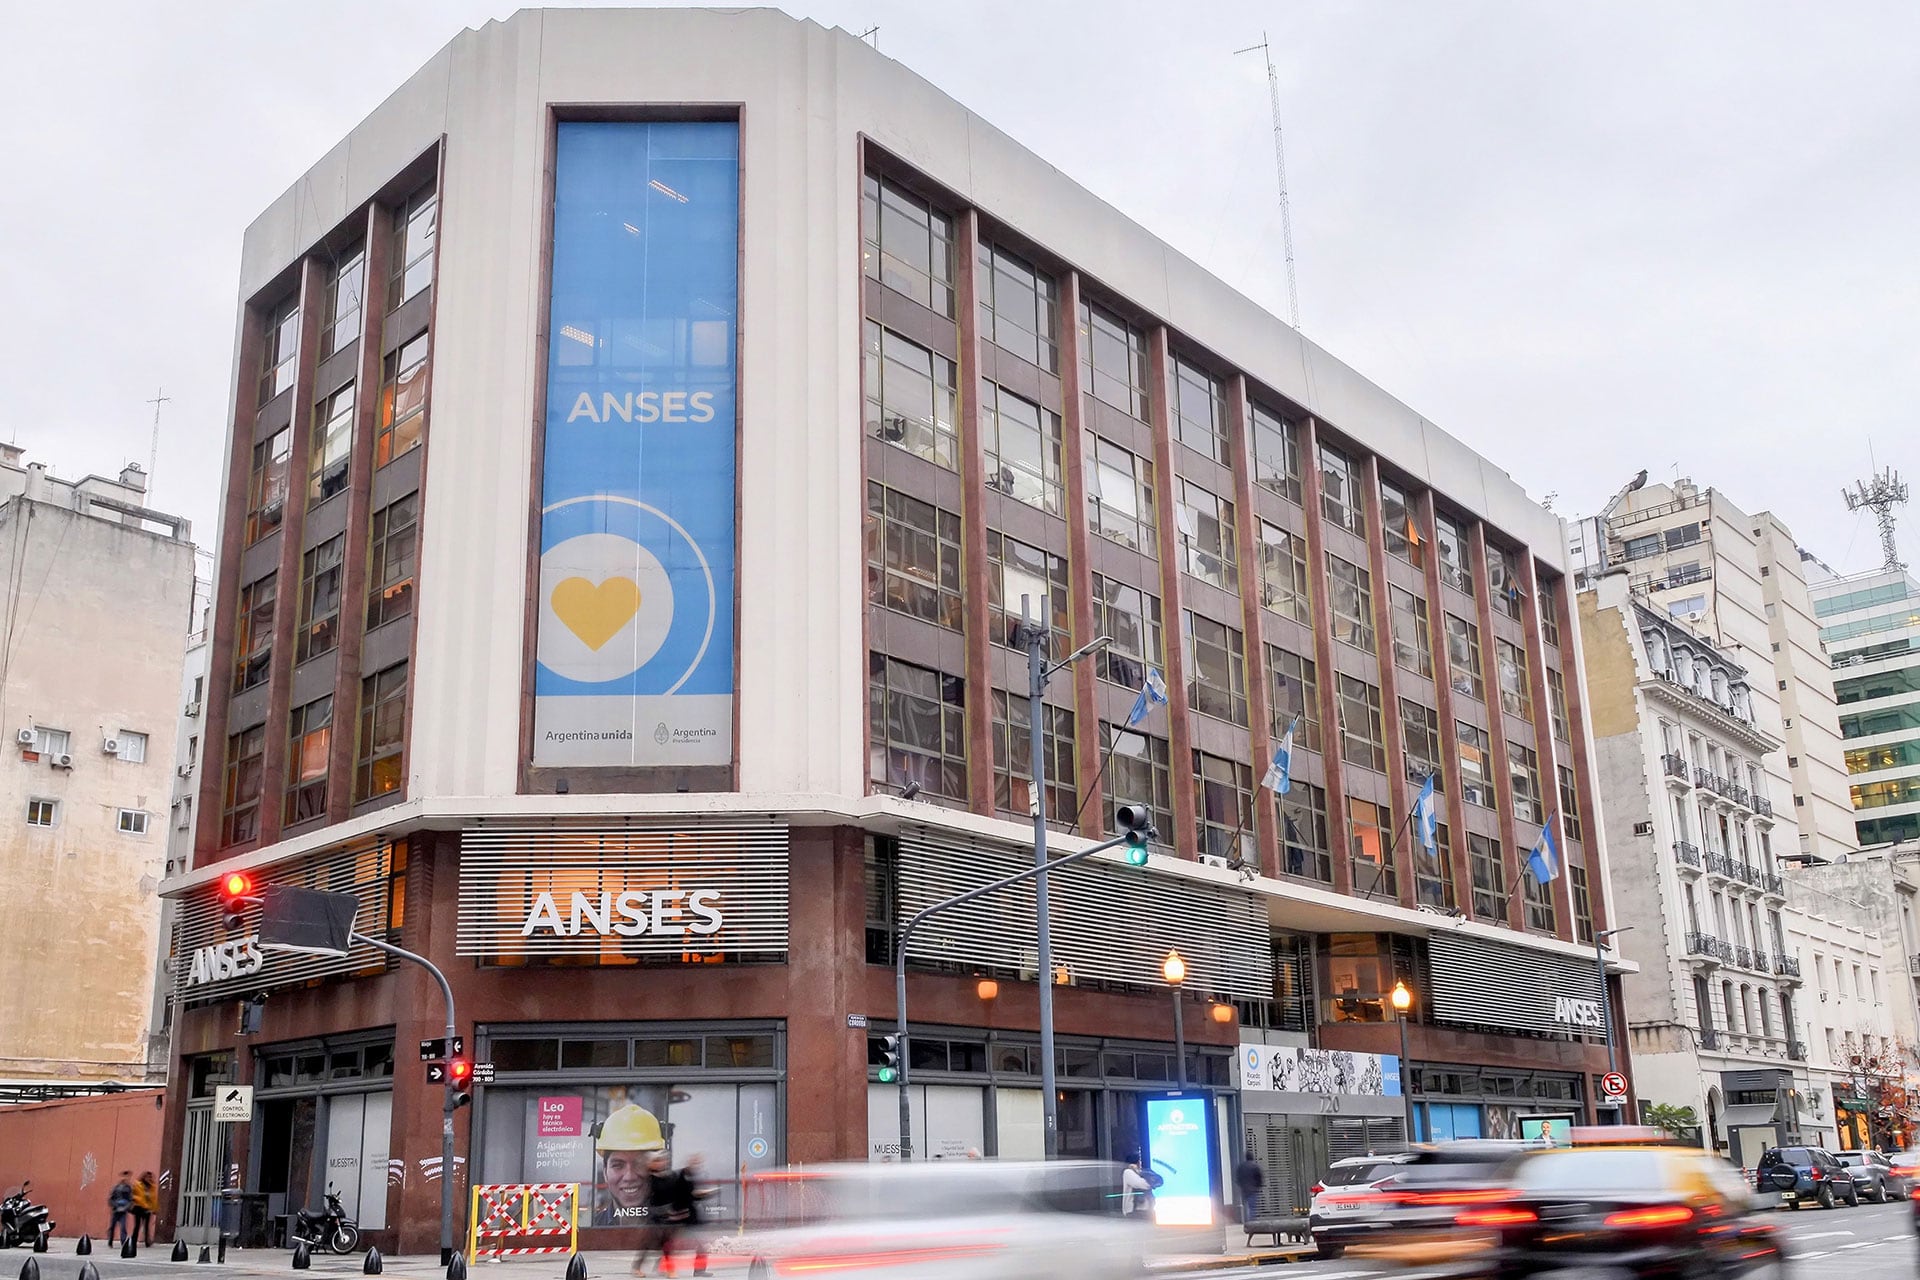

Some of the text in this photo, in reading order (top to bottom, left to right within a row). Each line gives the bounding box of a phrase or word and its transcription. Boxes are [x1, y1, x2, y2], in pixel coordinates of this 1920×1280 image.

[566, 391, 715, 423] ANSES
[545, 730, 632, 743] Argentina unida
[672, 727, 717, 739] Argentina
[521, 888, 723, 936] ANSES
[186, 934, 263, 988] ANSES
[1554, 996, 1600, 1027] ANSES
[1384, 1072, 1400, 1081] ANSES
[543, 1101, 565, 1112] Leo
[1318, 1095, 1340, 1113] 720
[536, 1141, 583, 1151] Asignación
[536, 1149, 575, 1158] universal
[536, 1159, 570, 1169] por hijo
[613, 1206, 649, 1217] ANSES
